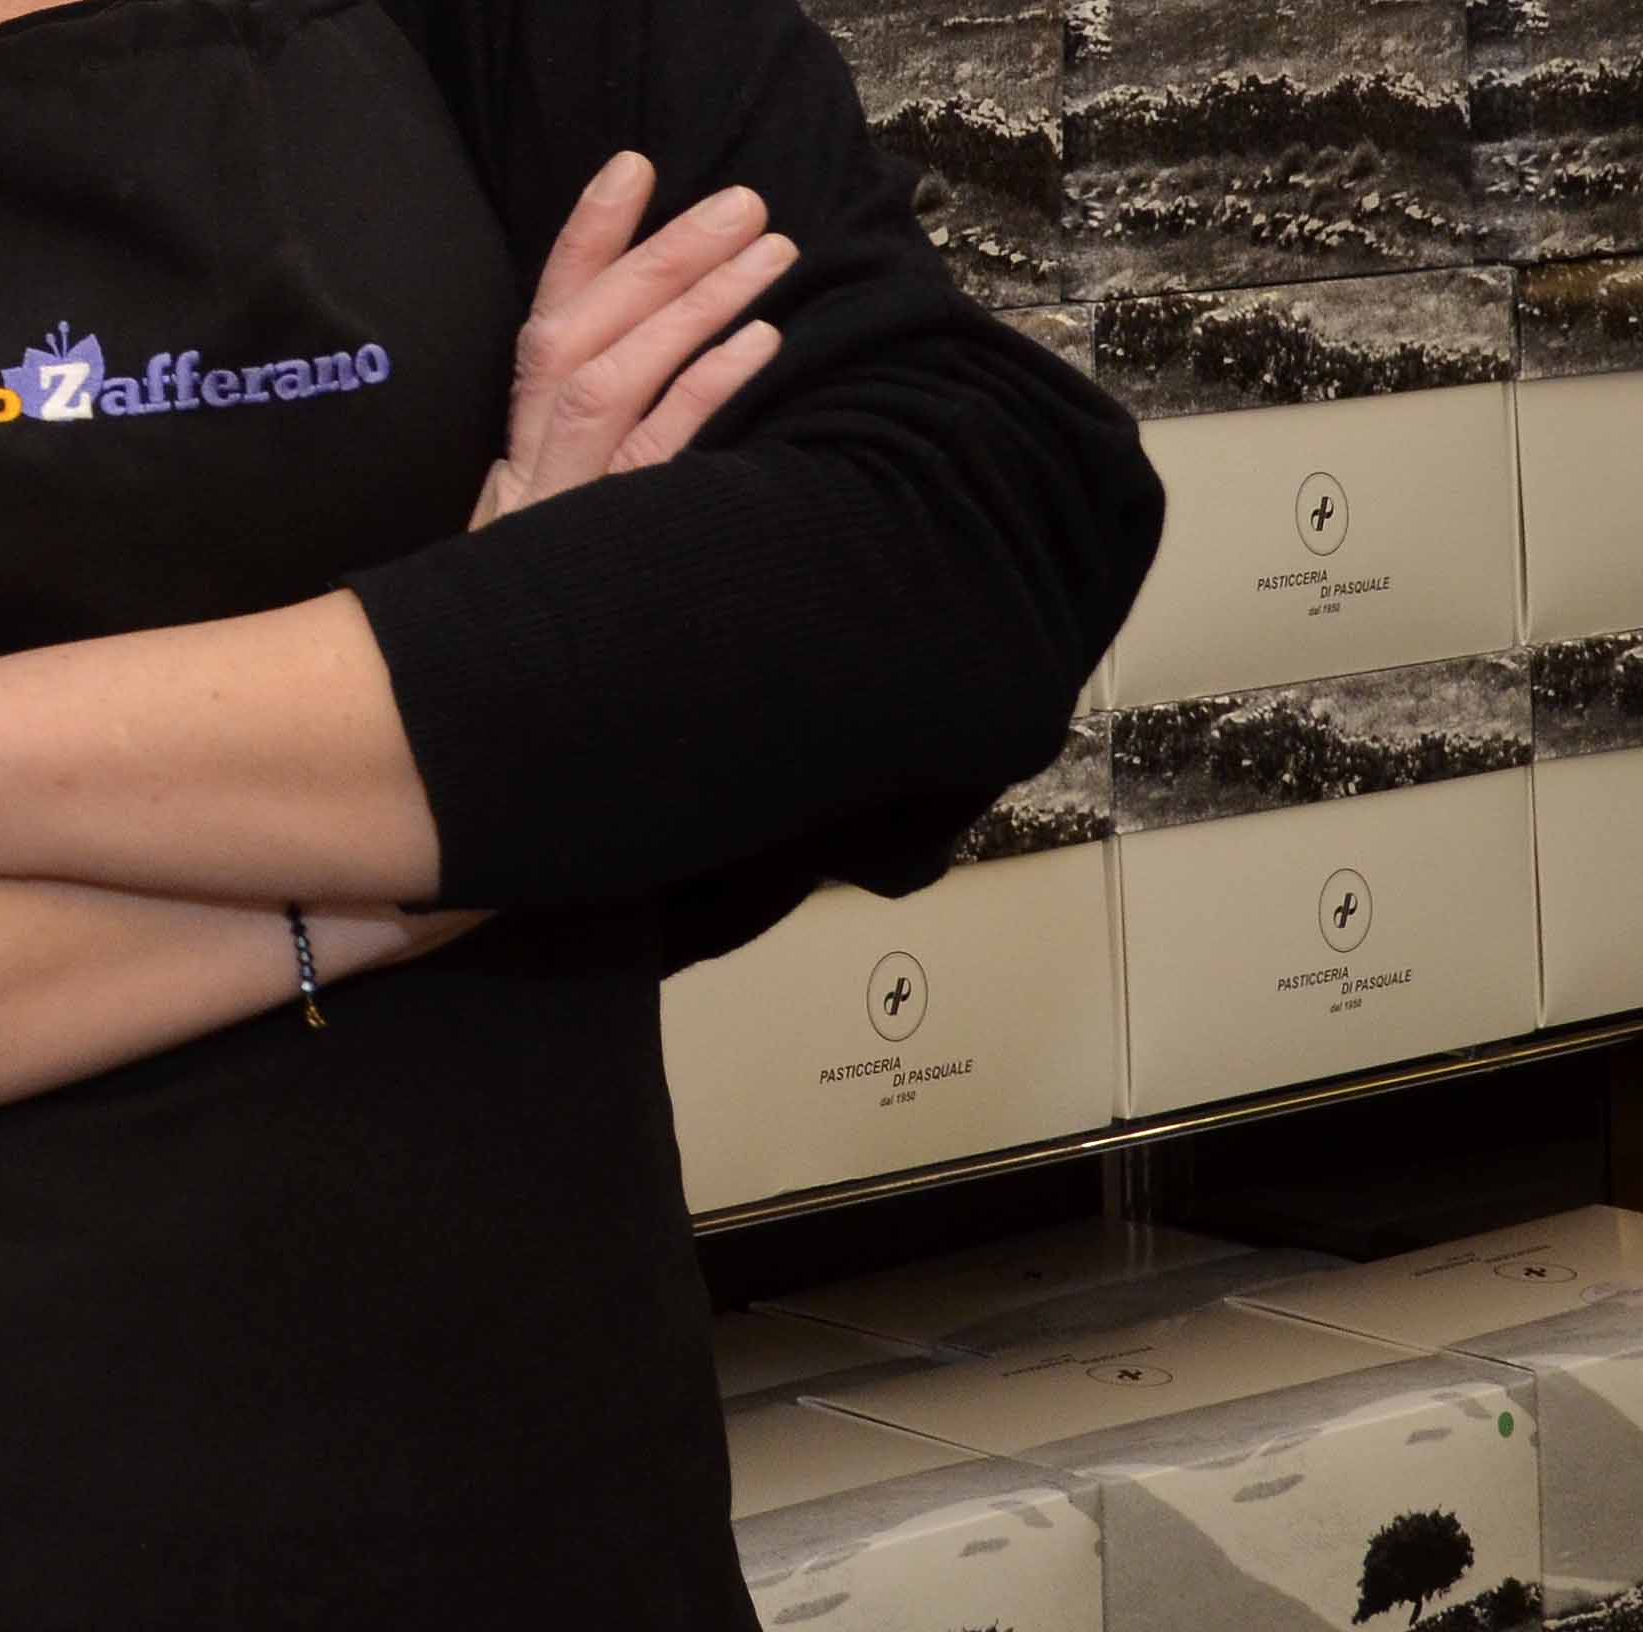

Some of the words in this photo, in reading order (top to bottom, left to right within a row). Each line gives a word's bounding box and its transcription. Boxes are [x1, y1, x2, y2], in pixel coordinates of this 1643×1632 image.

[1257, 569, 1328, 592] PASTICCERIA
[1320, 585, 1331, 599] DI
[1333, 576, 1390, 597] PASQUALE
[1277, 967, 1349, 992] PASTICCERIA
[1341, 982, 1353, 995] DI
[1354, 969, 1412, 992] PASQUALE
[819, 1057, 901, 1084] PASTICCERIA
[892, 1073, 905, 1088] DI
[908, 1059, 973, 1084] PASQUALE
